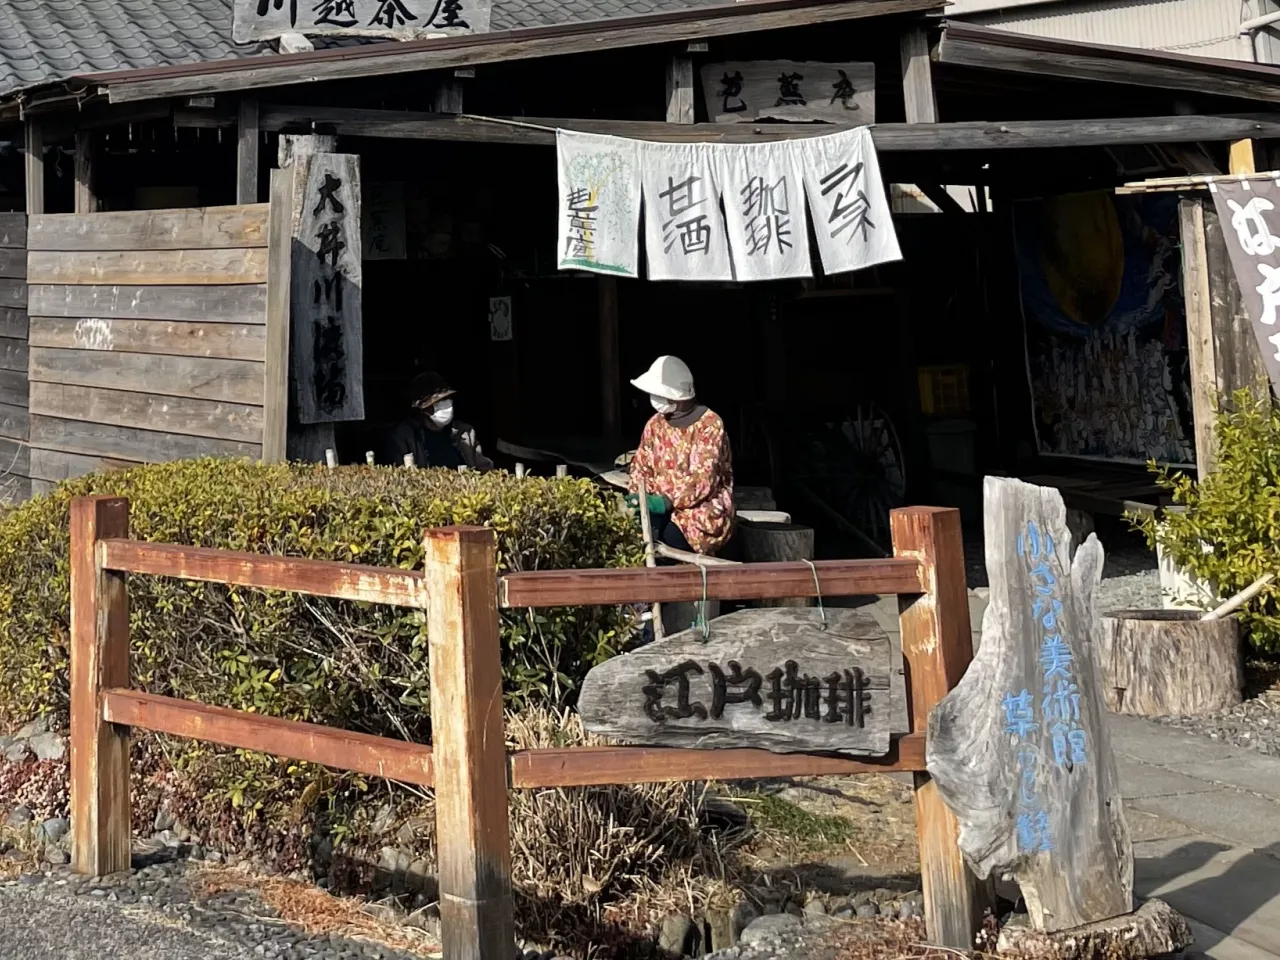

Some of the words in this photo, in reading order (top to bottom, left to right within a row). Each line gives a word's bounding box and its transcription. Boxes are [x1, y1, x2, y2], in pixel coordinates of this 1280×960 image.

[659, 176, 712, 255] 甘酒
[740, 176, 793, 256] 珈琲
[820, 162, 876, 246] ラムネ
[1018, 520, 1087, 765] 小さな美術館
[642, 659, 872, 728] 江戸珈琲
